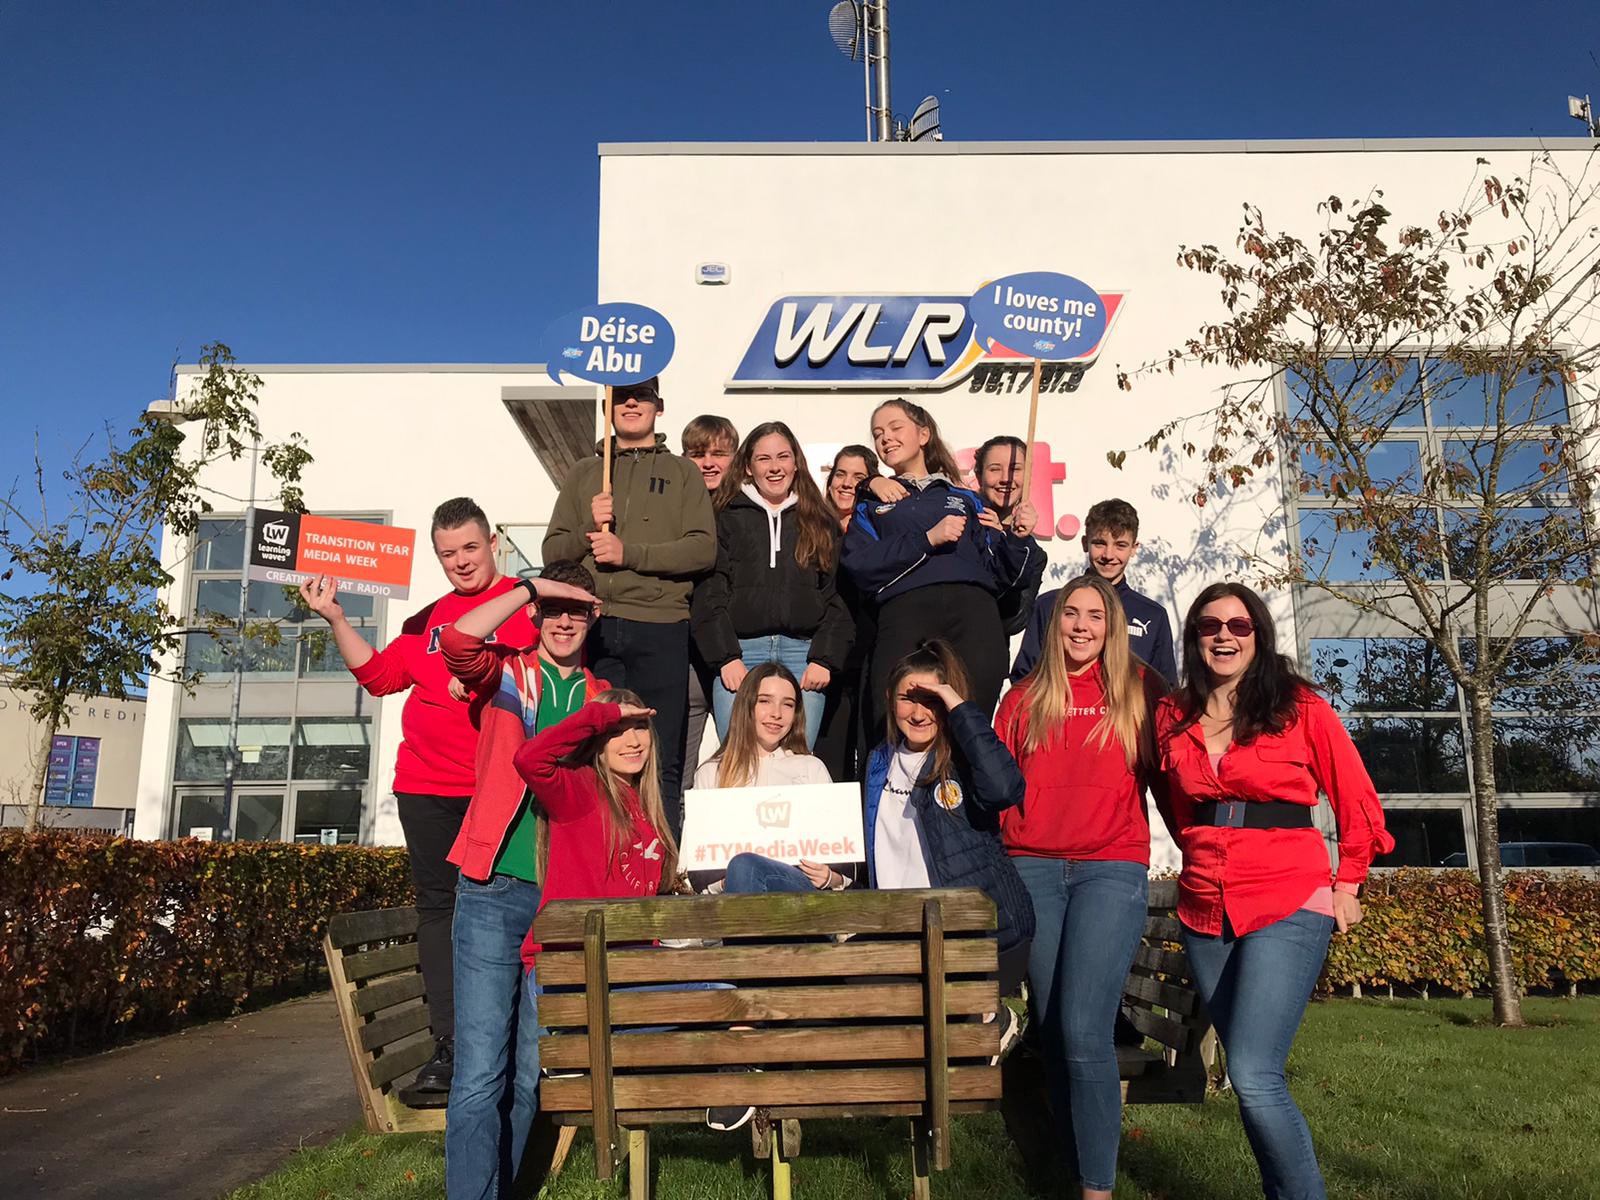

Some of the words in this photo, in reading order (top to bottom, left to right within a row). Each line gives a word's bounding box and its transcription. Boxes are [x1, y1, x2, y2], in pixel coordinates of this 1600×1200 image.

[994, 286, 1001, 304] I
[1006, 287, 1058, 312] loves
[1064, 299, 1096, 317] me
[580, 316, 656, 343] Déise
[774, 303, 965, 362] WLR
[1004, 314, 1081, 341] county!
[586, 346, 641, 373] Abu
[305, 533, 375, 551] TRANSITION
[380, 543, 409, 556] YEAR
[262, 553, 286, 562] waves
[304, 549, 341, 563] MEDIA
[346, 554, 378, 568] WEEK
[266, 571, 315, 584] CREATIN
[357, 583, 390, 596] RADIO
[68, 705, 146, 722] CREDI
[1063, 707, 1096, 716] ETTER
